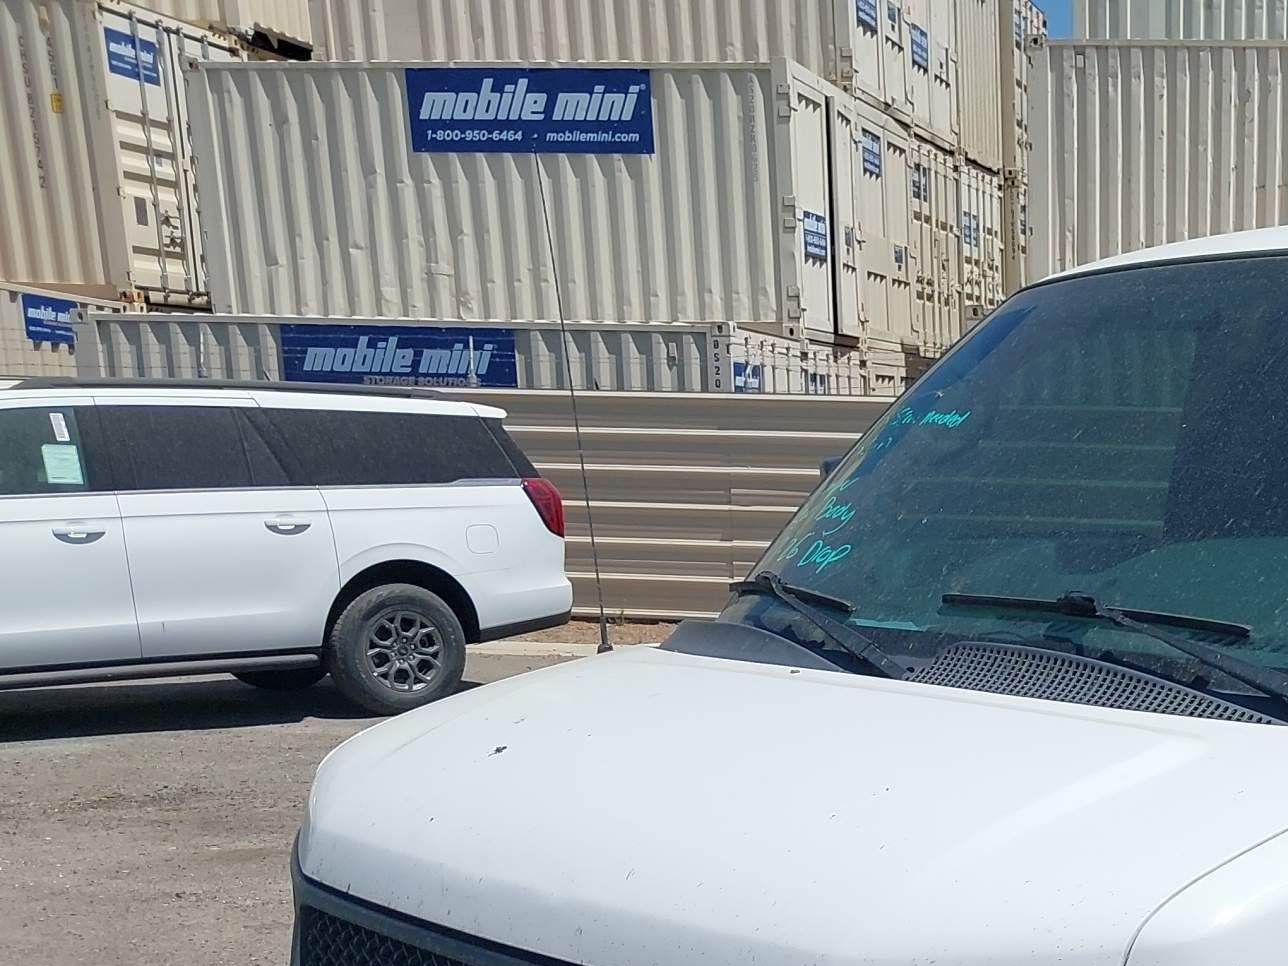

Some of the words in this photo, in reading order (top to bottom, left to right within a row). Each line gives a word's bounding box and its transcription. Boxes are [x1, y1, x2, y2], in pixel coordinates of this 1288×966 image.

[419, 78, 547, 121] mobile
[551, 85, 640, 121] mini
[426, 129, 523, 142] 1-800-950-6464
[546, 130, 640, 143] mobilemini.com
[303, 336, 415, 373] mobile
[418, 343, 494, 375] mini
[363, 375, 416, 386] STORAGE
